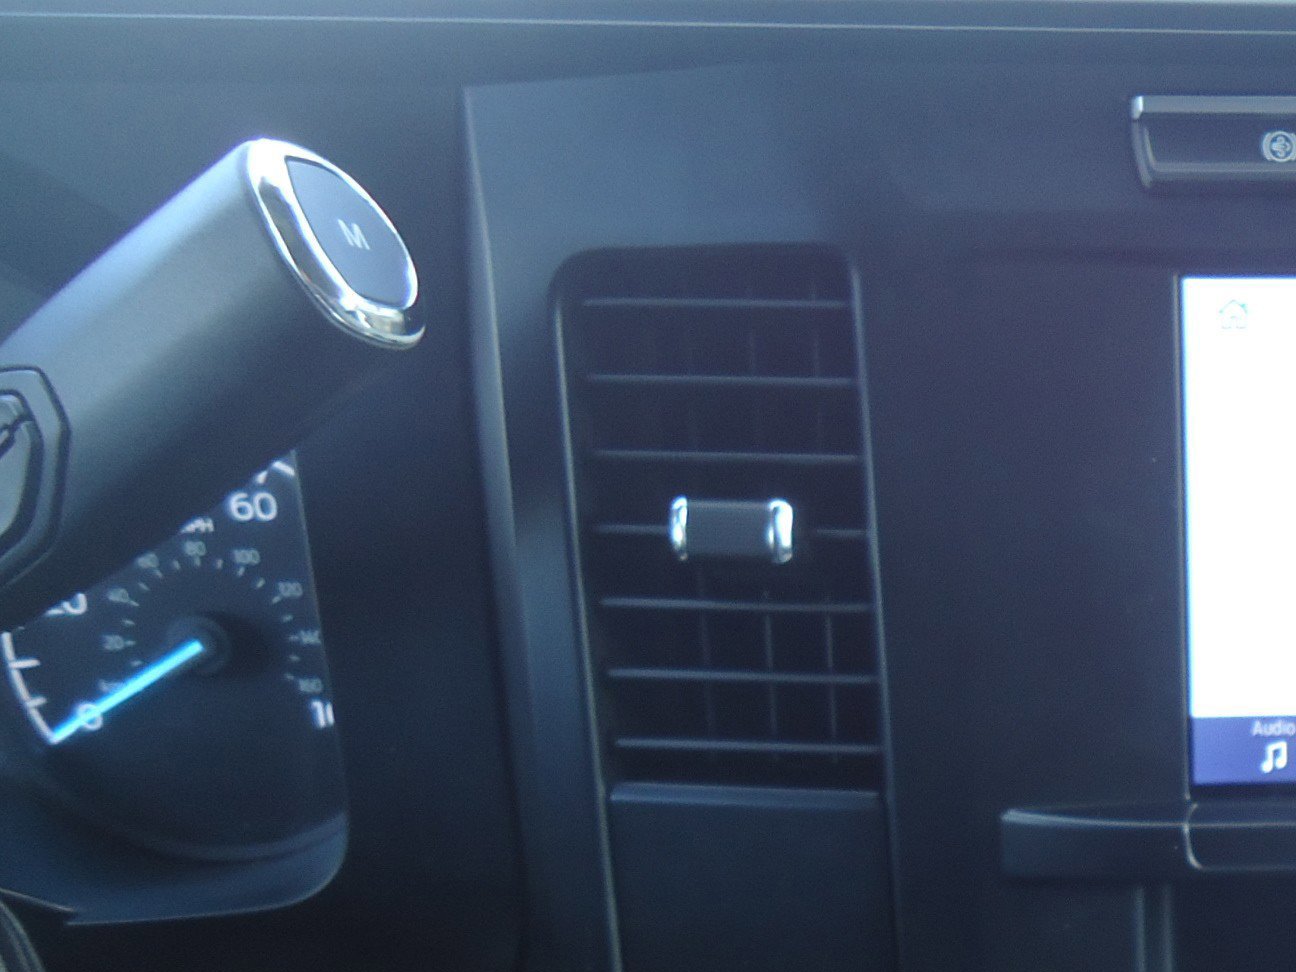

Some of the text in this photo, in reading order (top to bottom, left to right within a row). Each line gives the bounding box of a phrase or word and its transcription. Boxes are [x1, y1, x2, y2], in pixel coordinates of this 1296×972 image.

[337, 218, 370, 250] M
[229, 491, 278, 521] 60
[1251, 718, 1296, 737] Audio
